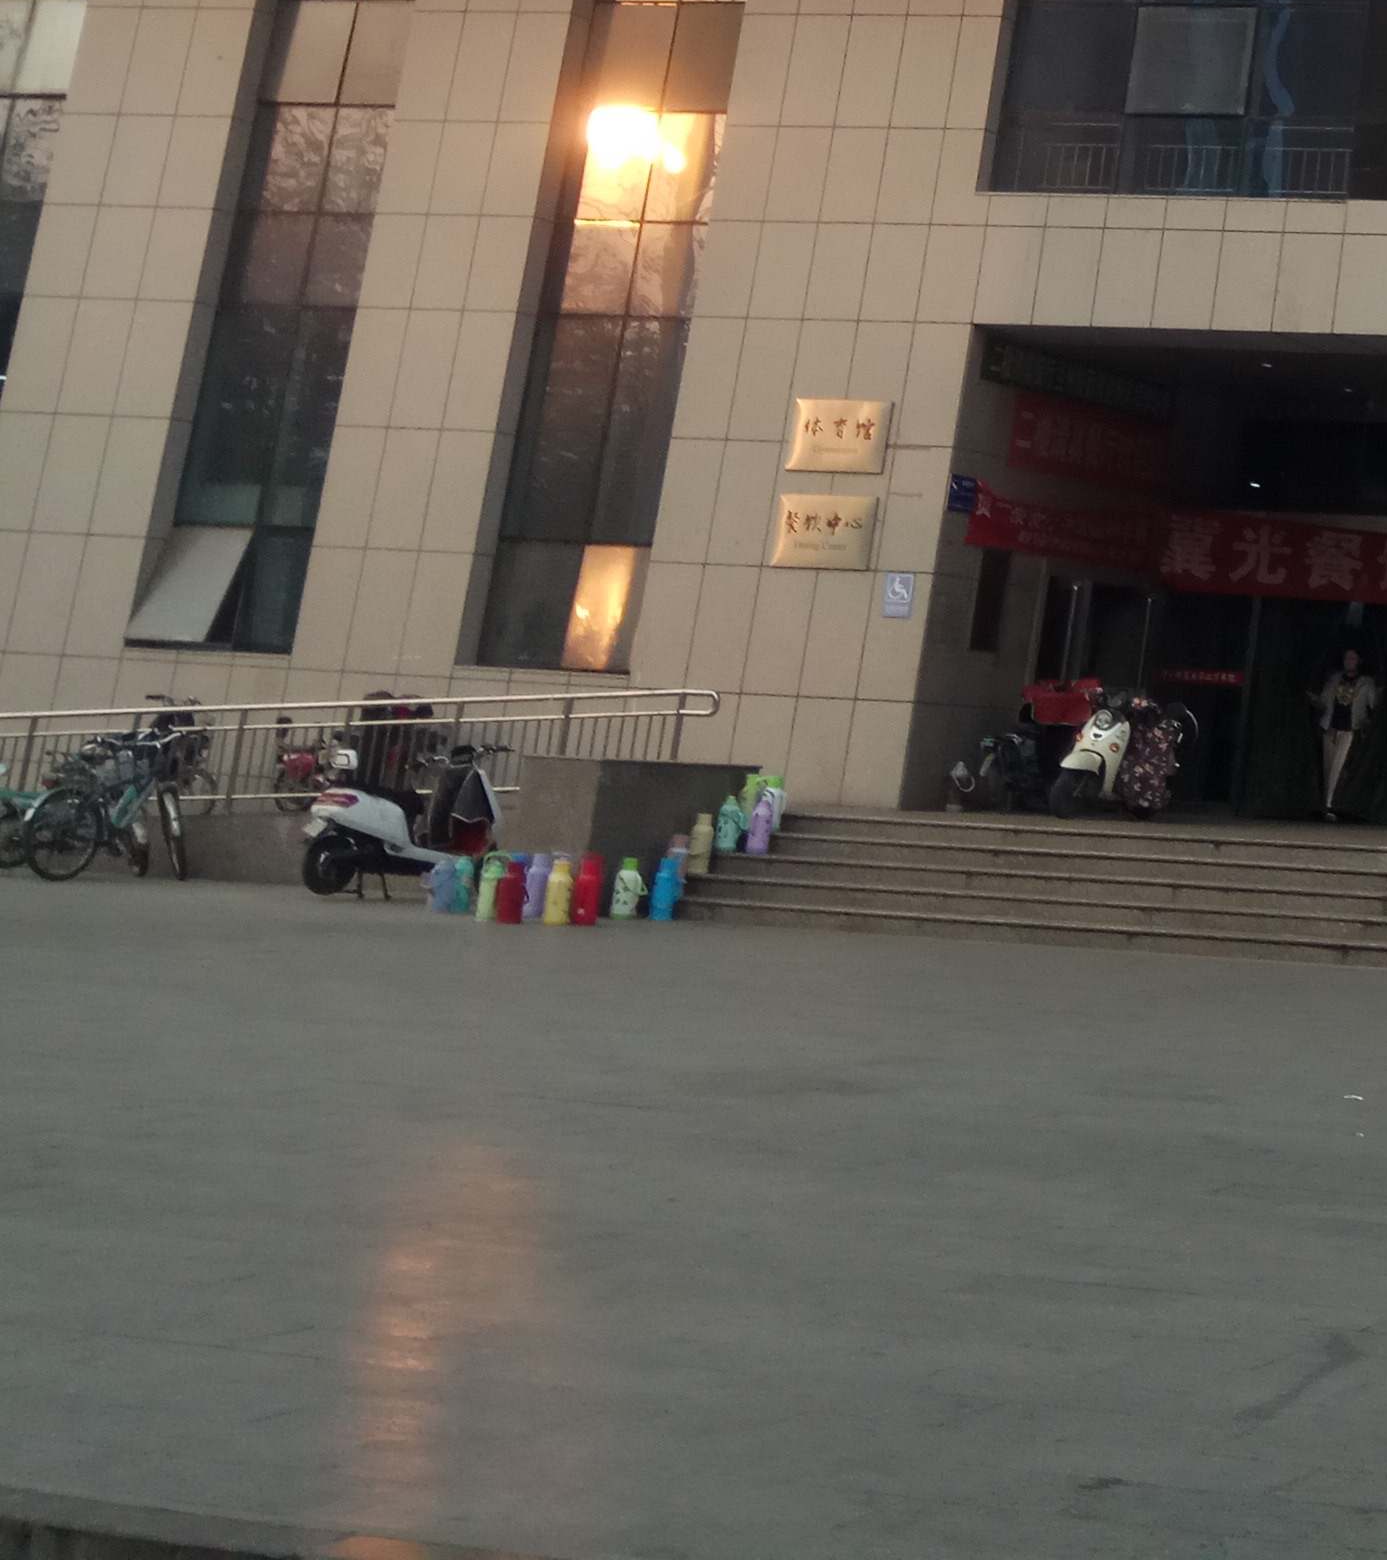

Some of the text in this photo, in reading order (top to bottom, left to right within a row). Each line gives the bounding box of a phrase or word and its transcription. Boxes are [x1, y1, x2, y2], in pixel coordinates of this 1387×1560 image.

[804, 417, 876, 441] 体育馆
[785, 510, 863, 536] 餐饮中心
